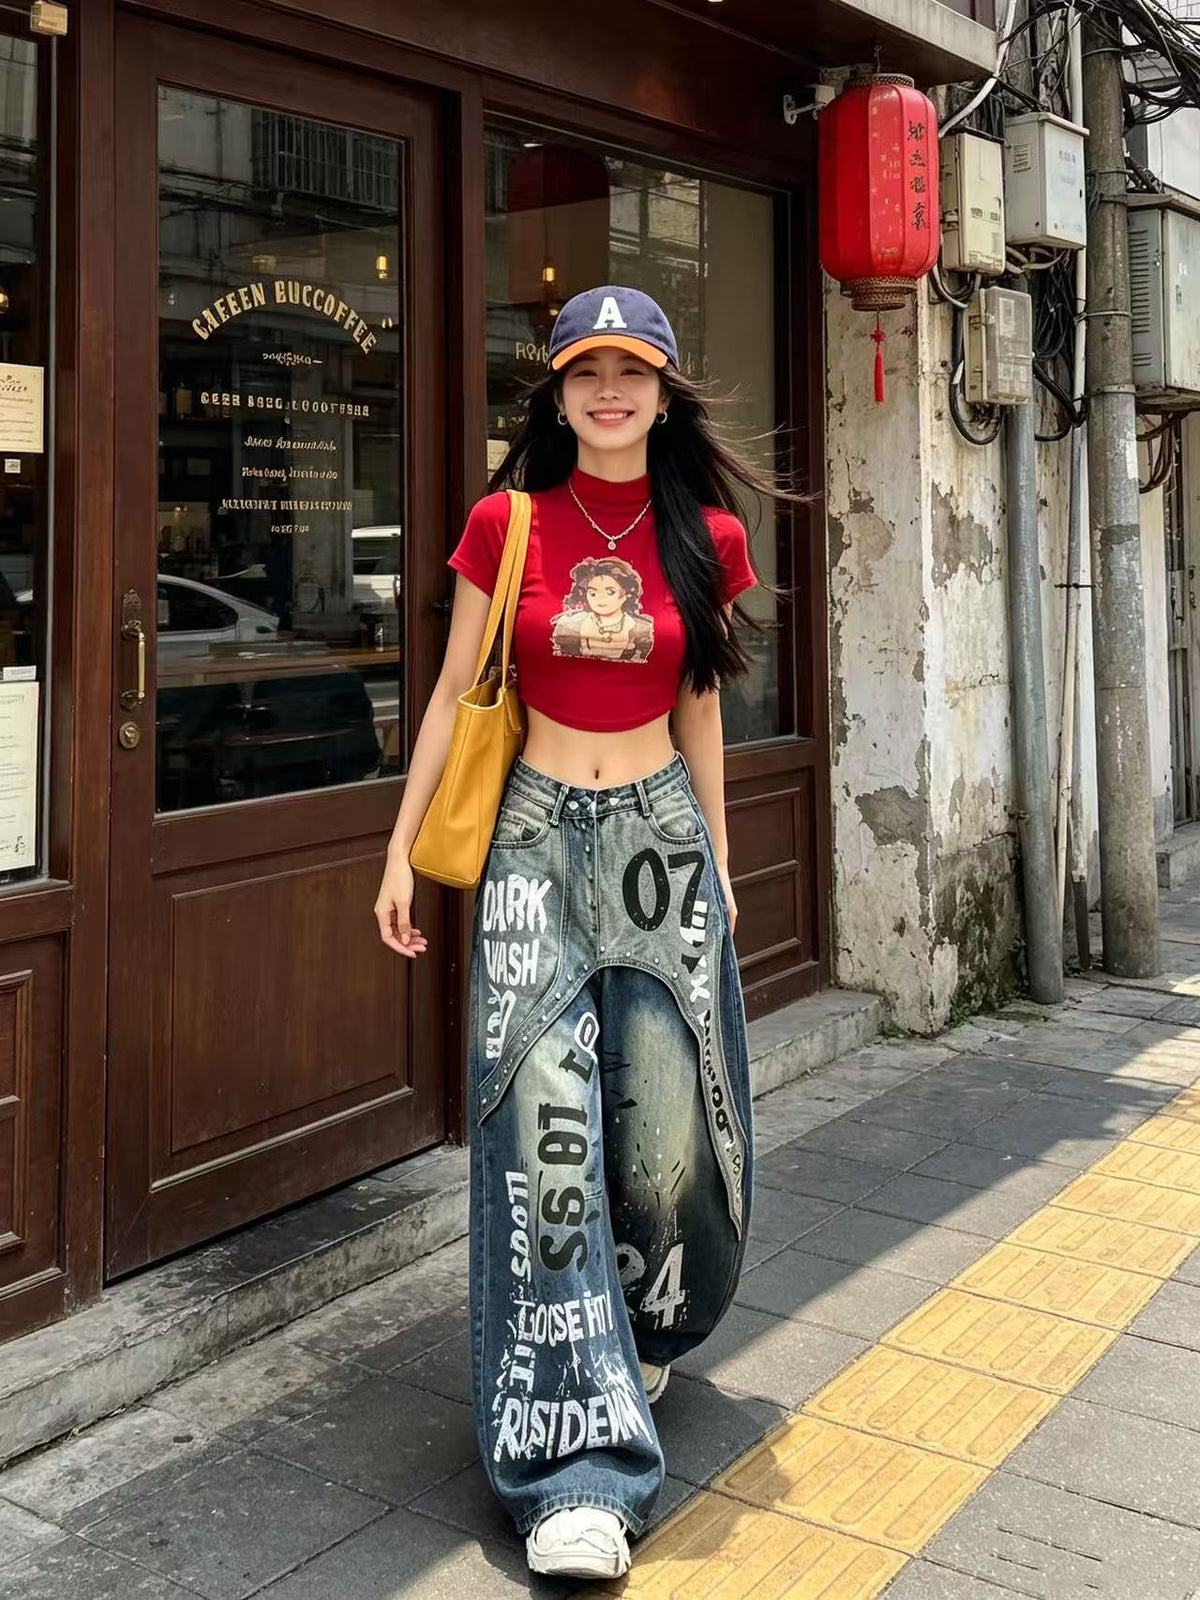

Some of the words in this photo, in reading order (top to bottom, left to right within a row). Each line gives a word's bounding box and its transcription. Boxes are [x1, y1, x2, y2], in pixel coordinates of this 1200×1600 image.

[593, 296, 627, 330] A
[483, 873, 553, 934] DARK
[622, 848, 705, 932] 07
